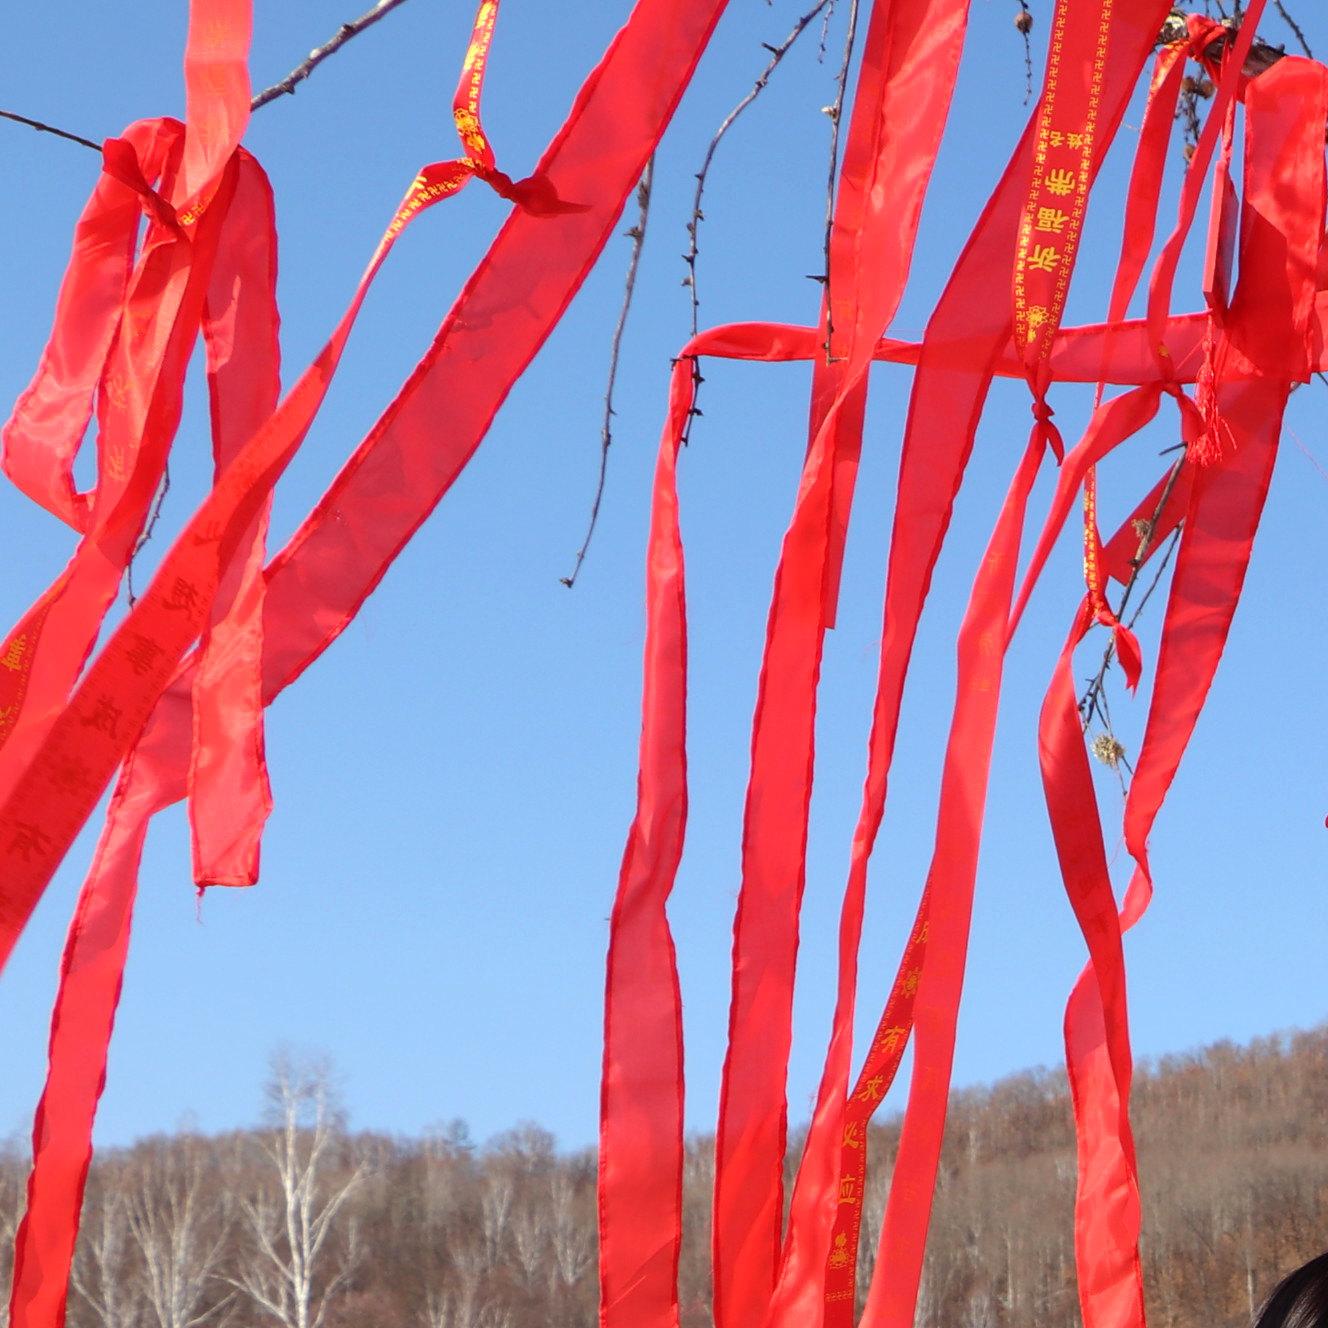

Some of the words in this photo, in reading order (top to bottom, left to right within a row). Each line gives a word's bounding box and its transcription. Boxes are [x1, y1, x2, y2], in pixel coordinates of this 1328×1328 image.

[1049, 130, 1085, 149] 姓名
[1027, 166, 1076, 274] 祈福带
